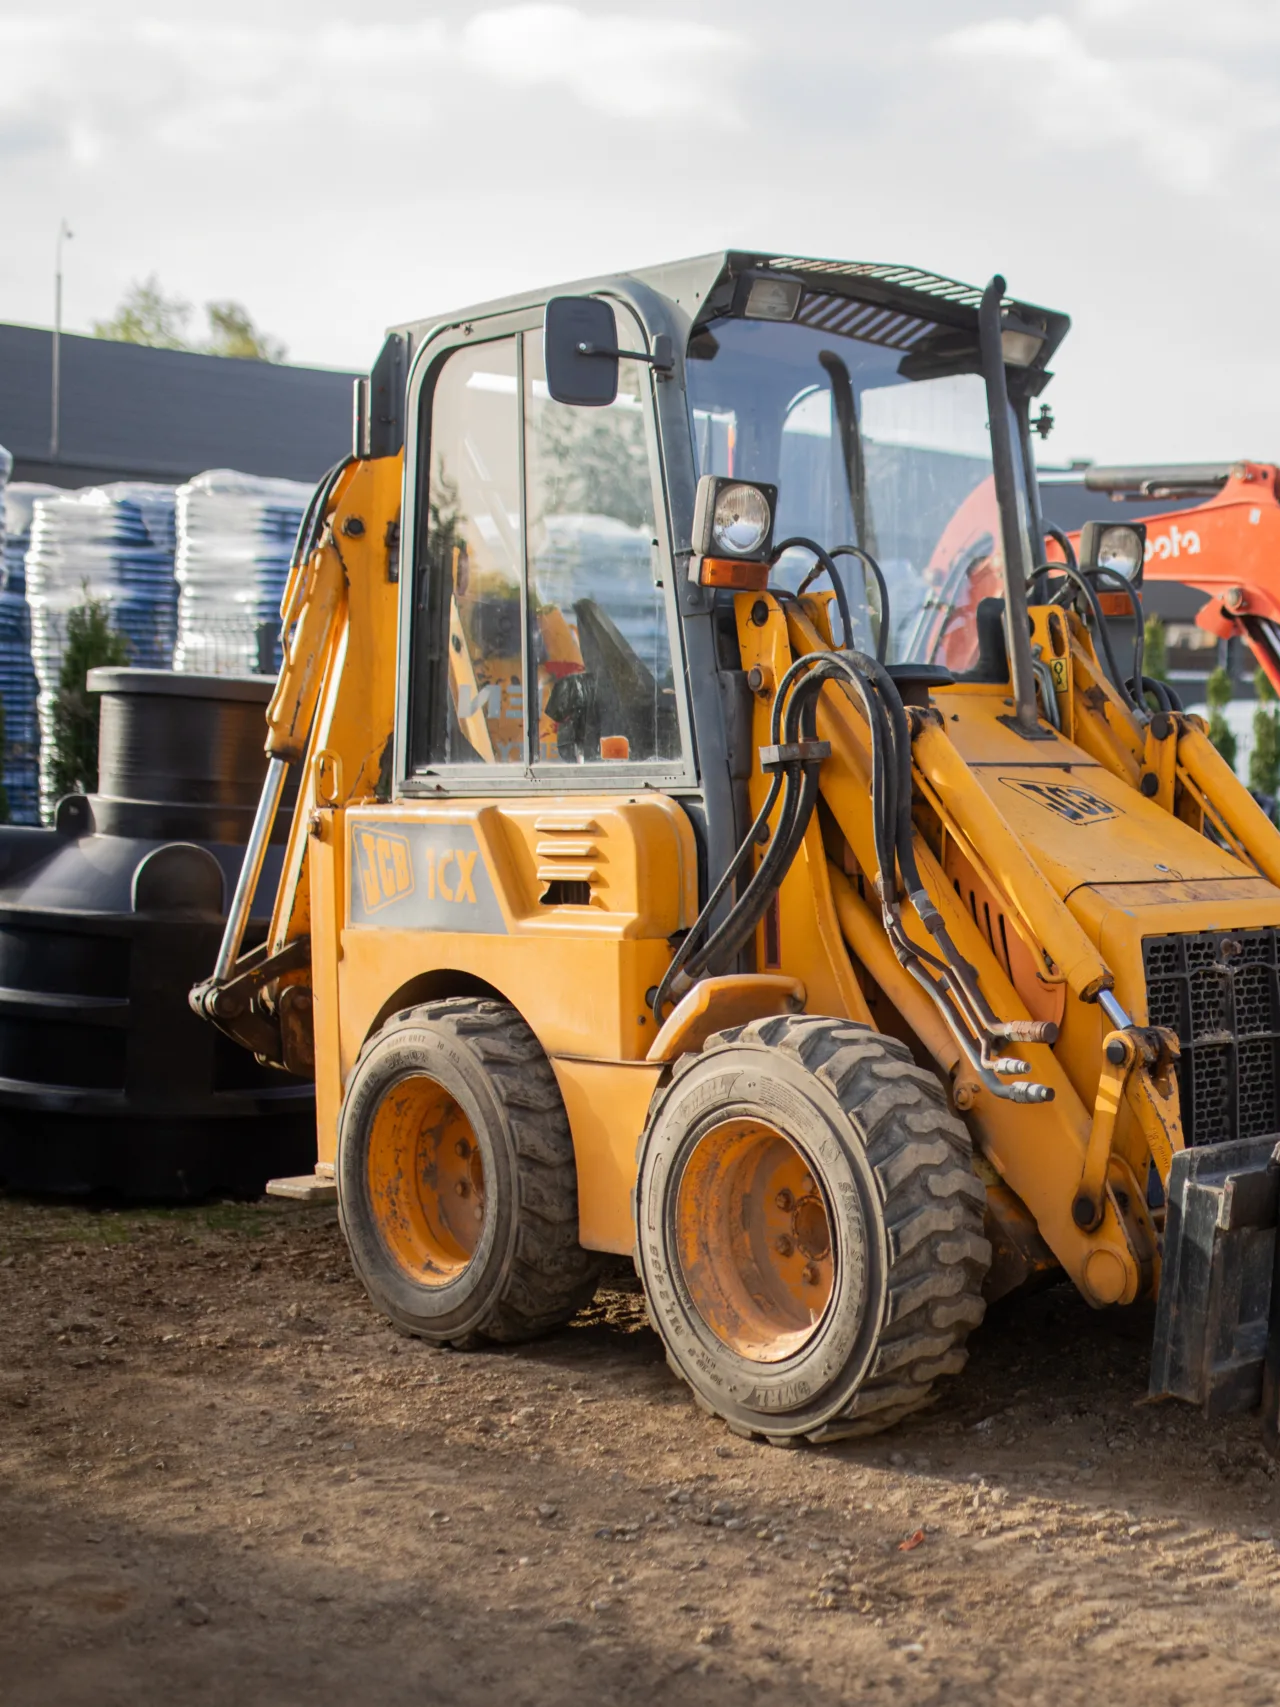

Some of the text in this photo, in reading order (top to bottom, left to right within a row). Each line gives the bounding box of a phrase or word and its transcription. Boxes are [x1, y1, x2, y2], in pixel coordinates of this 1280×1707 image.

[1017, 782, 1115, 821] JCB
[361, 833, 478, 906] JCB 1CX
